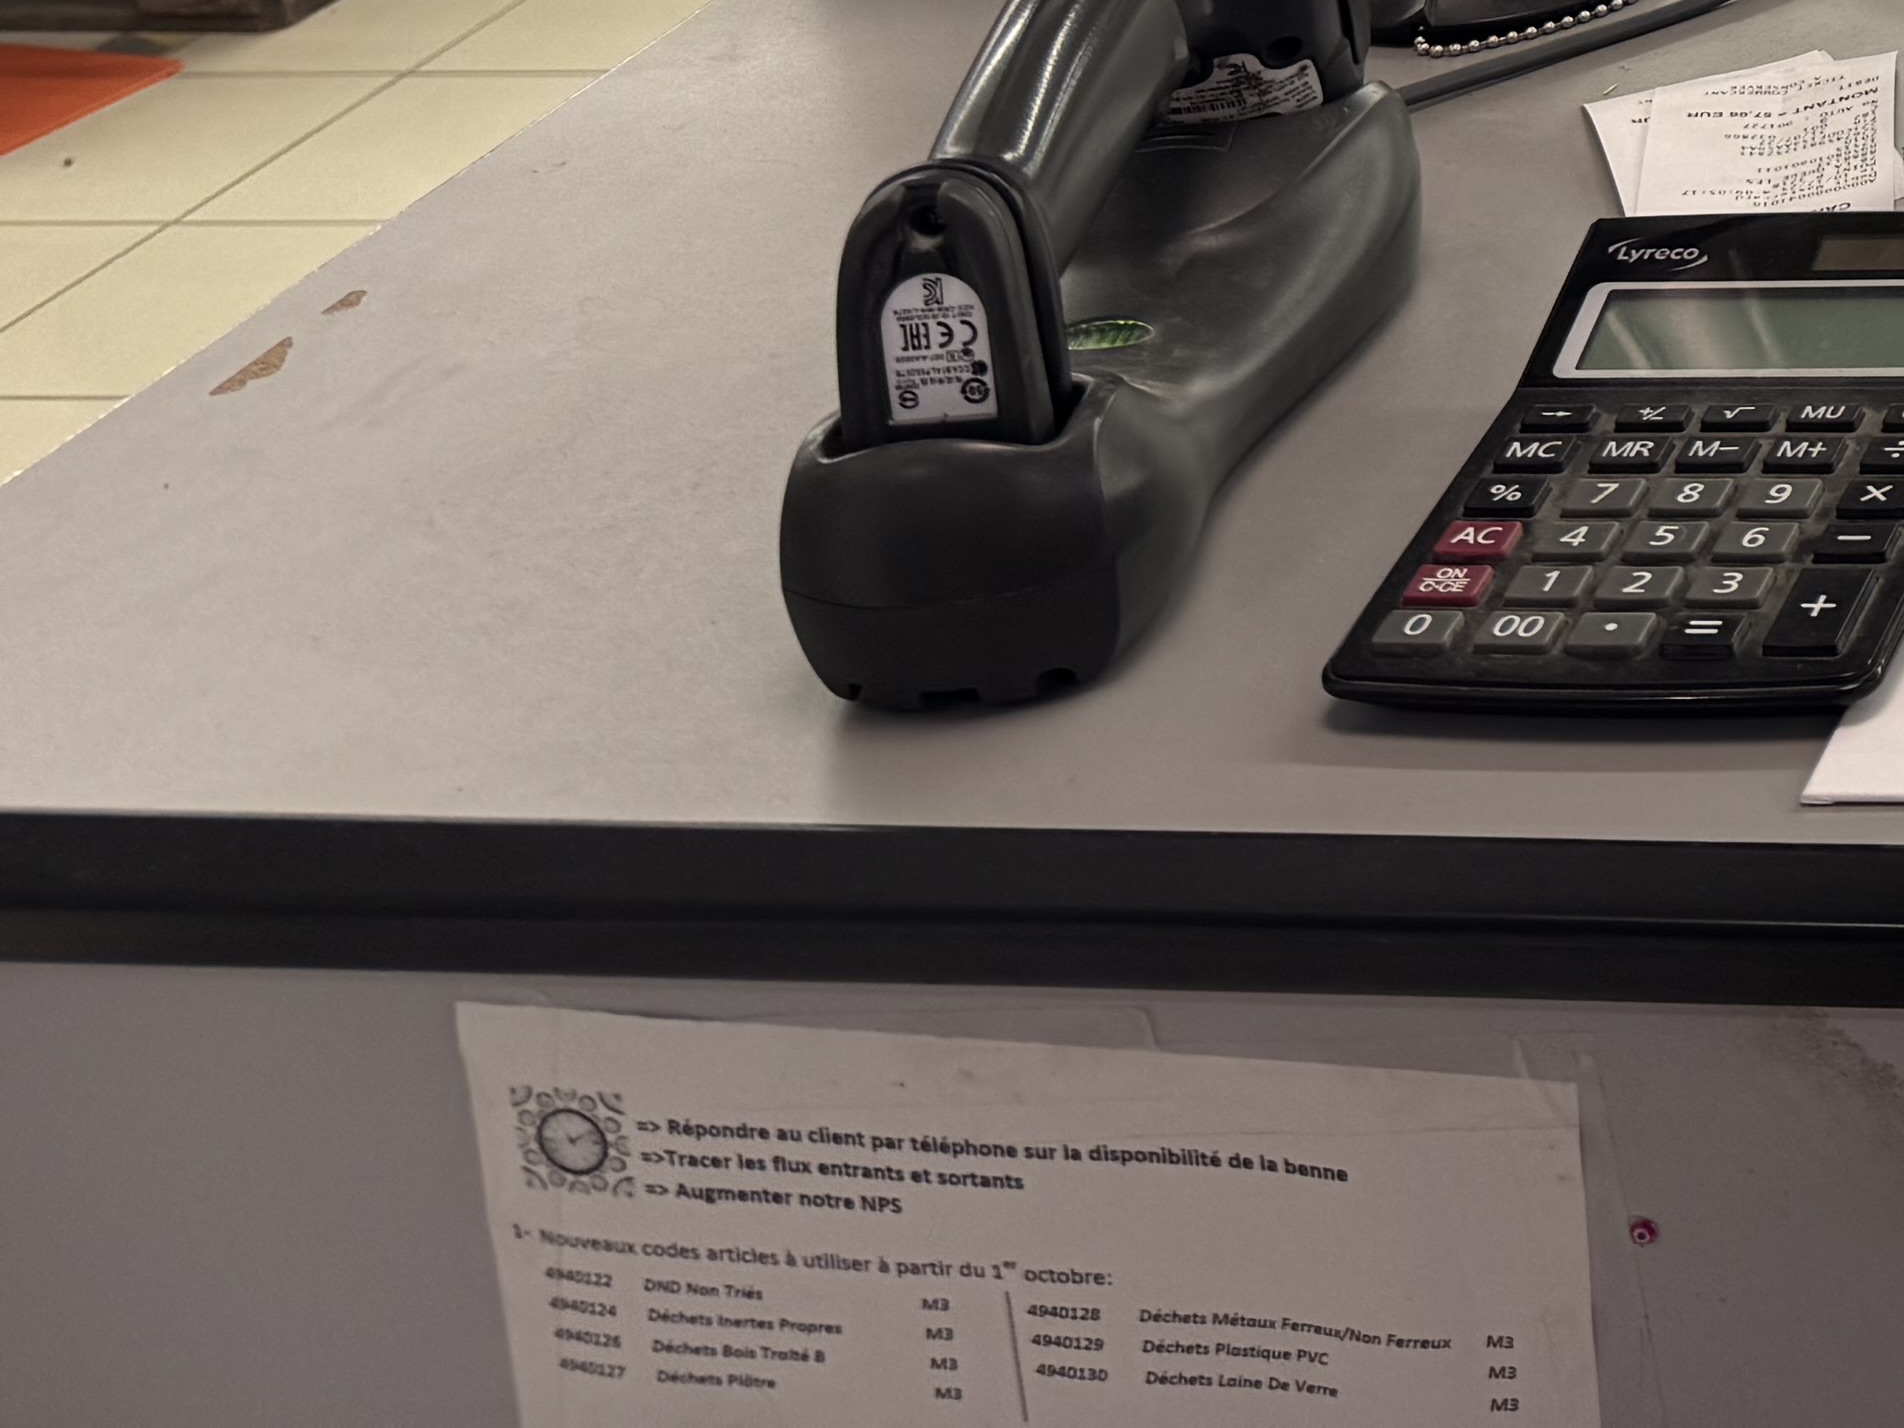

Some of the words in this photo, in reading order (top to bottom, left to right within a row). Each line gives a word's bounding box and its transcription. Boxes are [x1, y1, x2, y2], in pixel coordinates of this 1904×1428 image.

[1616, 242, 1702, 264] Lyreco
[1504, 439, 1564, 460] MC
[1451, 525, 1502, 545] AC
[667, 1118, 771, 1144] Répondre
[777, 1127, 802, 1143] au
[807, 1126, 865, 1148] client
[871, 1133, 907, 1152] par
[909, 1134, 1017, 1160] téléphone
[1024, 1144, 1057, 1164] sur
[1062, 1142, 1082, 1163] la
[1088, 1144, 1224, 1170] disponibilité
[1228, 1150, 1254, 1170] de
[1258, 1151, 1280, 1174] la
[1284, 1152, 1350, 1183] benne
[738, 1153, 766, 1173] les
[773, 1155, 812, 1175] flux
[818, 1162, 904, 1183] entrants
[911, 1168, 931, 1184] et
[937, 1171, 1024, 1190] sortants
[675, 1182, 792, 1206] Augmenter
[799, 1192, 855, 1211] notre
[860, 1195, 903, 1215] NPS
